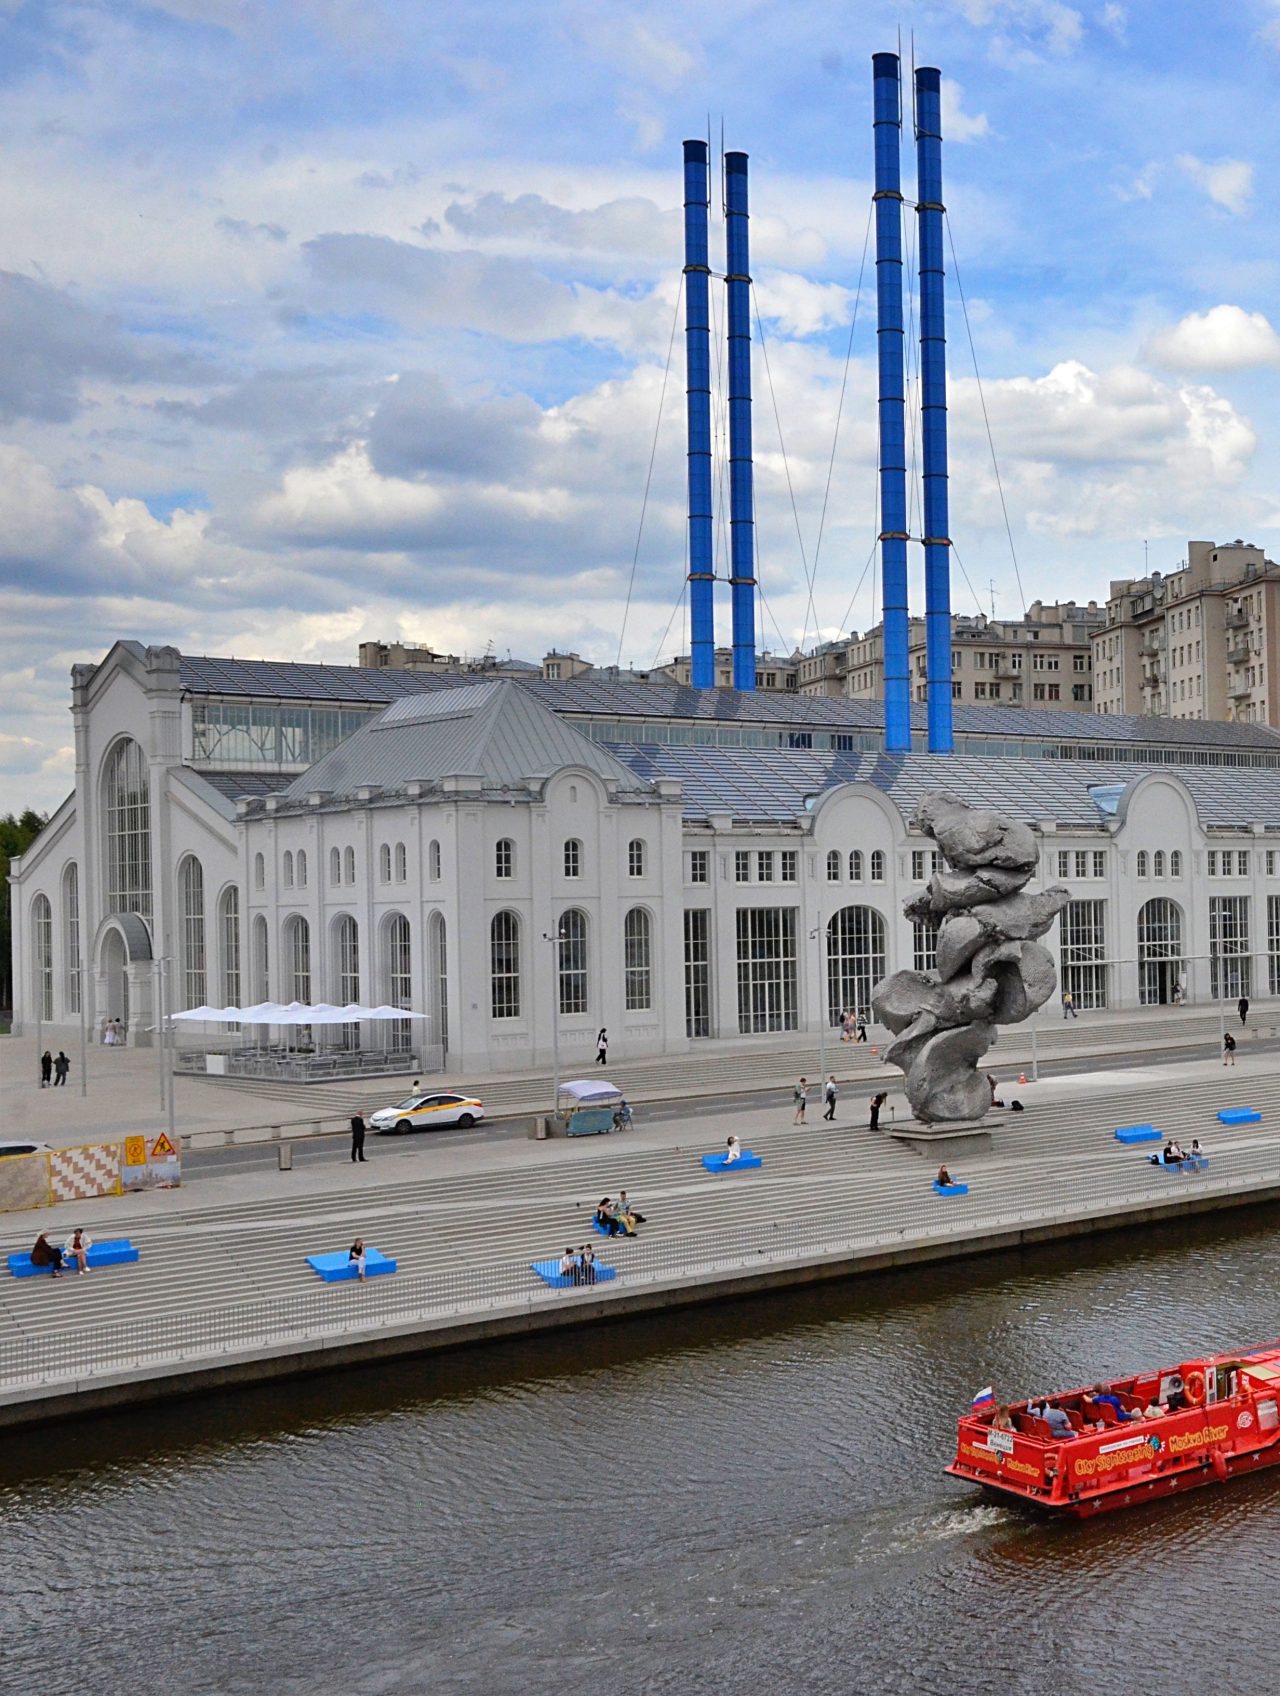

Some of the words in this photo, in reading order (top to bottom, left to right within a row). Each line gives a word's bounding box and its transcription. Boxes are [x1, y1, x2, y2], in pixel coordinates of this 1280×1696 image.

[1169, 1432, 1203, 1453] Moskva
[1203, 1425, 1229, 1443] River
[1075, 1459, 1096, 1475] City
[1096, 1443, 1154, 1471] Sightseeing
